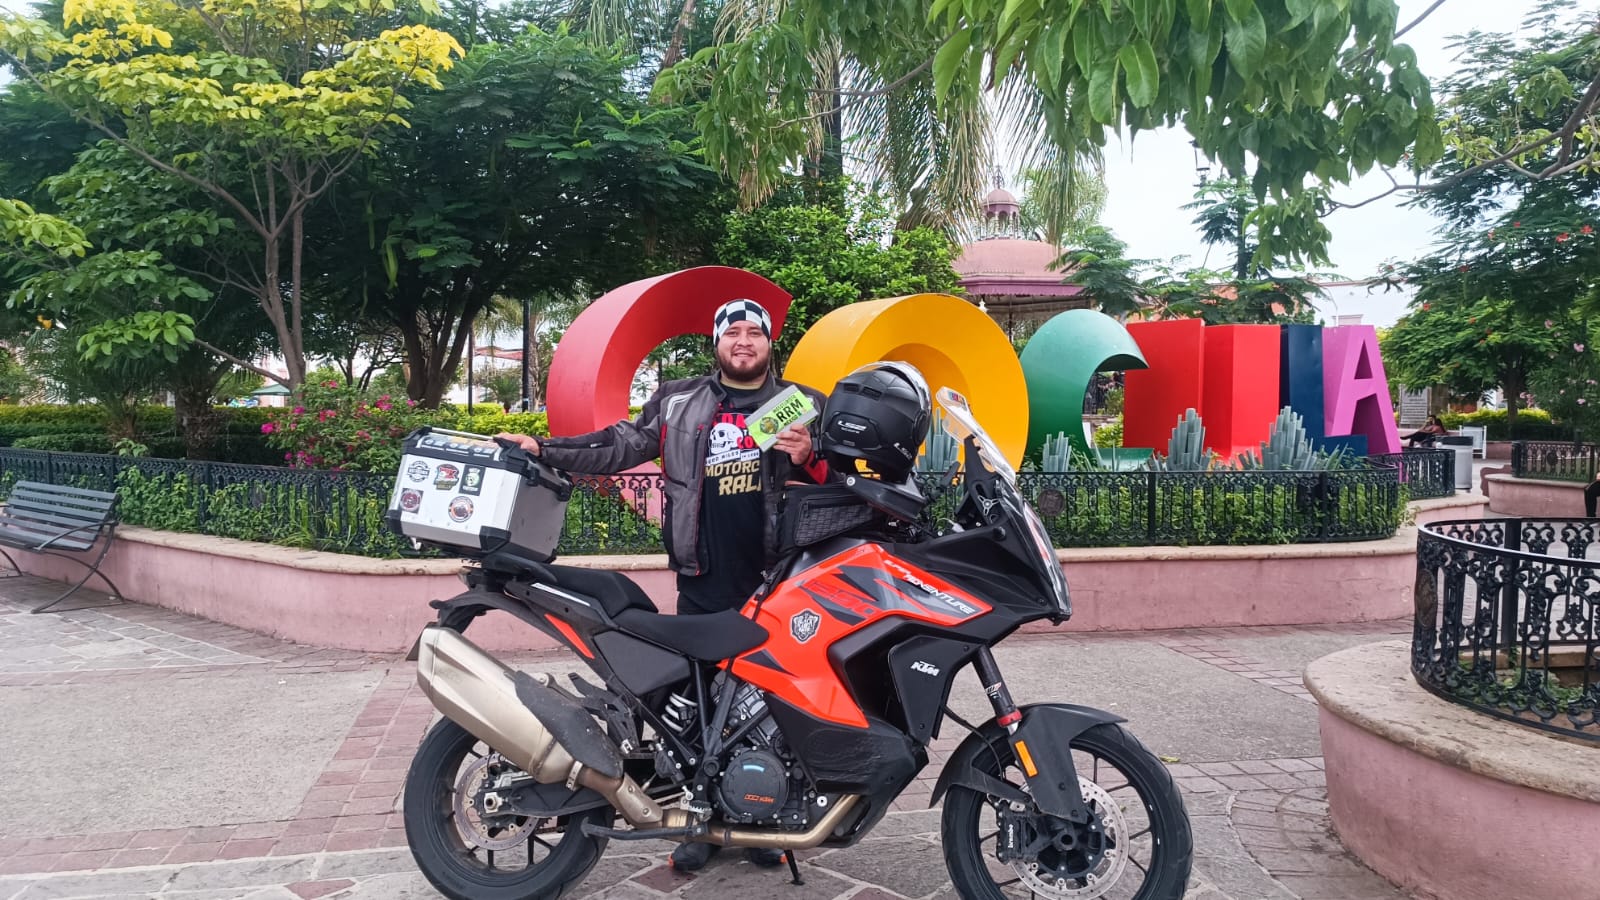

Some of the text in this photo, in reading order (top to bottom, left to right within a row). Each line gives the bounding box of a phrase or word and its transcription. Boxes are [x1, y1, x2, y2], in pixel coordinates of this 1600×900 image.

[776, 398, 804, 422] RRM
[837, 420, 867, 432] LS2
[737, 436, 757, 449] CO
[705, 460, 760, 477] MOTORC
[904, 574, 976, 614] ADVENTURE
[910, 661, 940, 677] KTM
